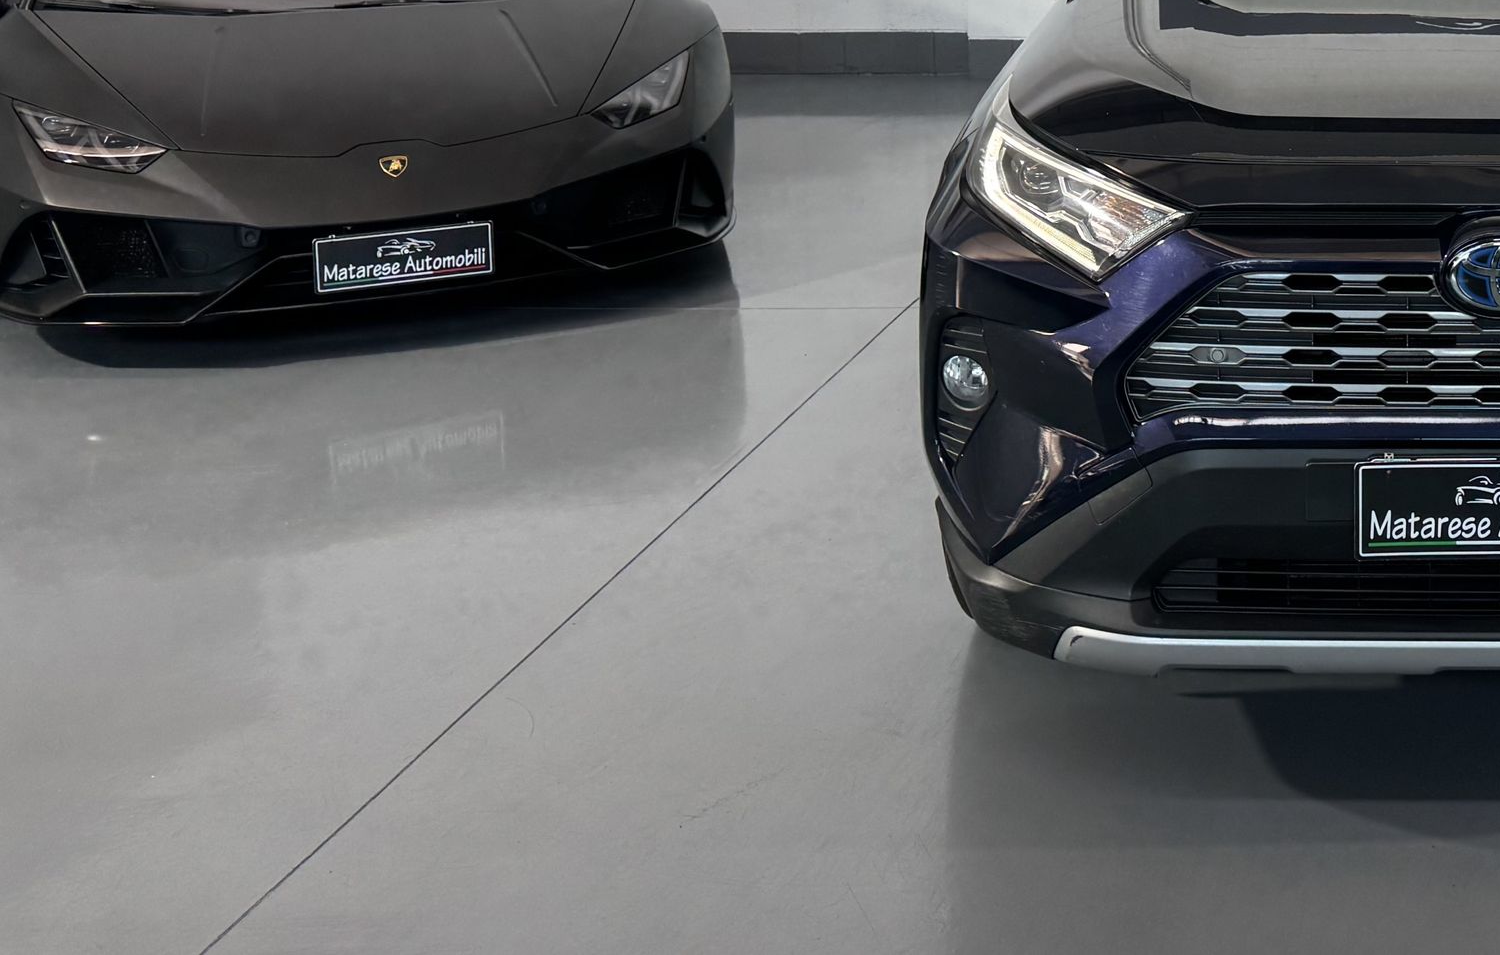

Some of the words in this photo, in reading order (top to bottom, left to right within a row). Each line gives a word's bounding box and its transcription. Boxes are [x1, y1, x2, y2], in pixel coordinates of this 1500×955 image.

[323, 261, 401, 283] Matarese
[404, 248, 486, 274] Automobili
[1369, 509, 1491, 540] Matarese
